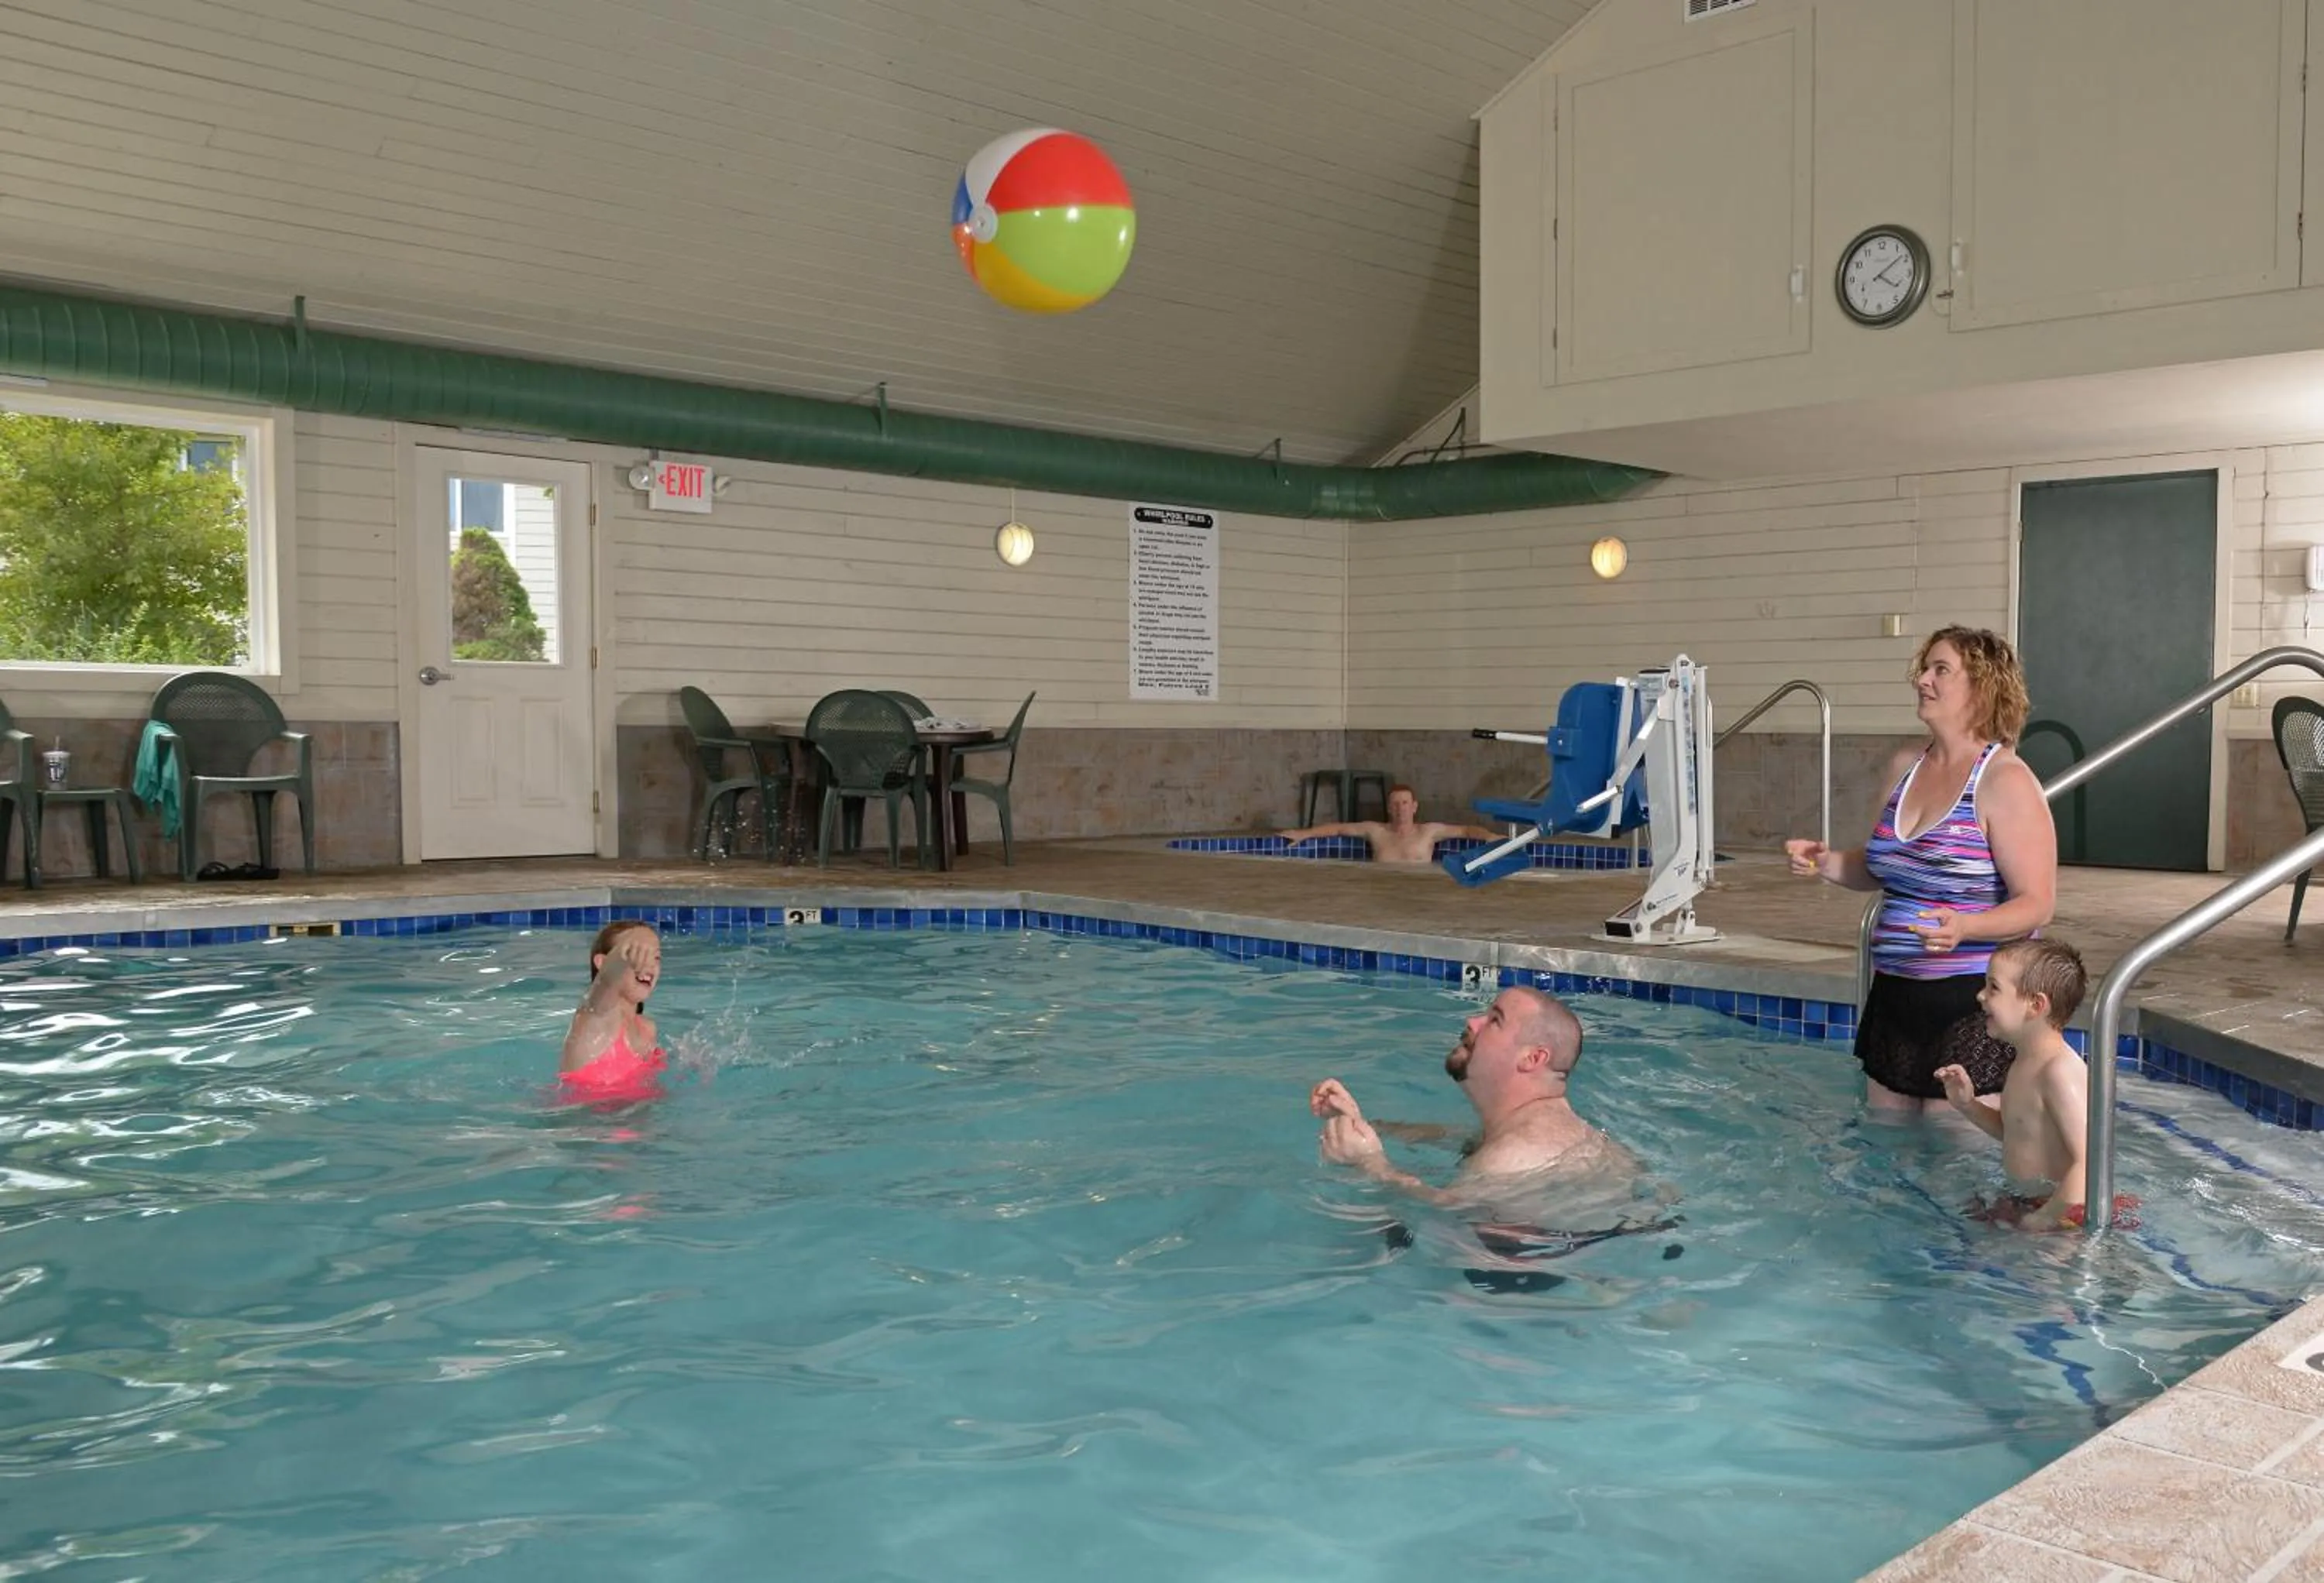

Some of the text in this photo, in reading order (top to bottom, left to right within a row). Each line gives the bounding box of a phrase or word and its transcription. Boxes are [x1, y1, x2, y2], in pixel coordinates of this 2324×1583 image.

[1878, 241, 1886, 249] 12
[665, 463, 706, 499] EXIT
[1143, 510, 1181, 520] WHIRLPOOL
[1184, 513, 1207, 523] RULES
[806, 910, 817, 921] FT
